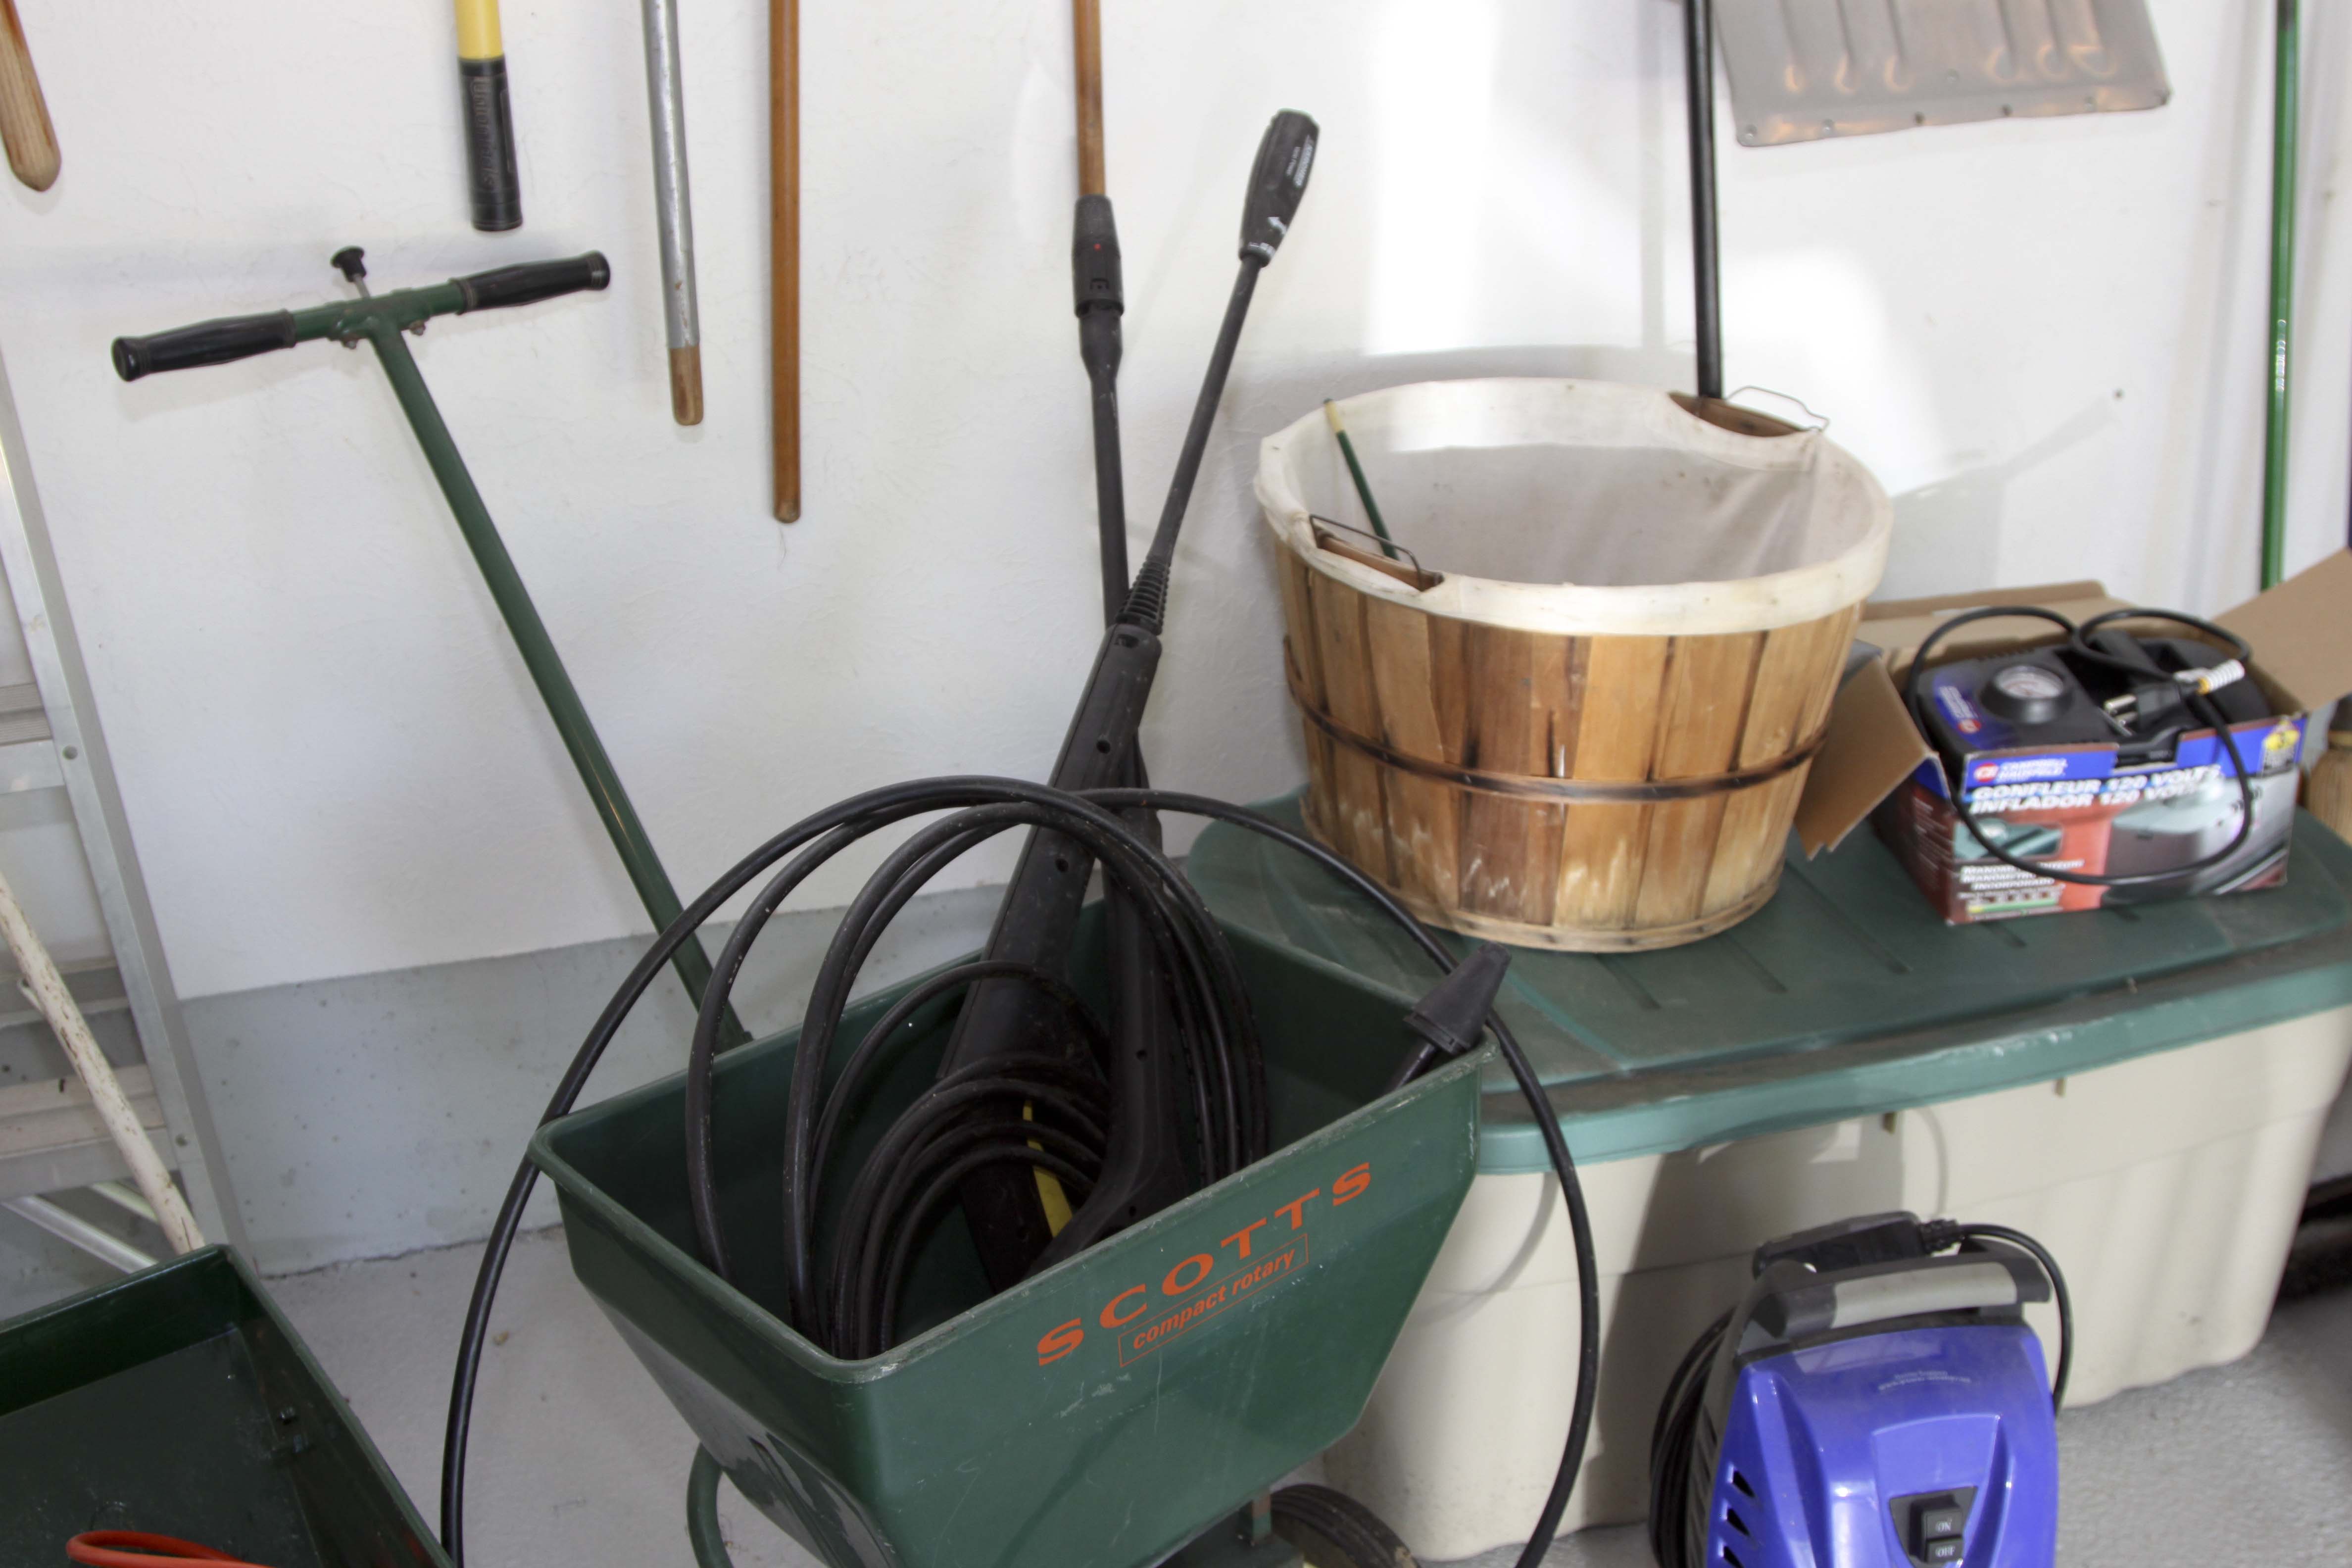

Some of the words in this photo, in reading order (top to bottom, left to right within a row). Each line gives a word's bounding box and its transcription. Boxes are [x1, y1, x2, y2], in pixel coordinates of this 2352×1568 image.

[1972, 779, 2101, 800] GONFLEUR
[2106, 775, 2148, 791] 120
[1969, 793, 2094, 814] INFLADOR
[2100, 789, 2140, 805] 120
[1037, 1162, 1372, 1366] SCOTTS
[1133, 1286, 1226, 1350] compact
[1232, 1249, 1296, 1295] rotary
[1936, 1521, 1952, 1533] ON
[1935, 1545, 1956, 1558] OFF
